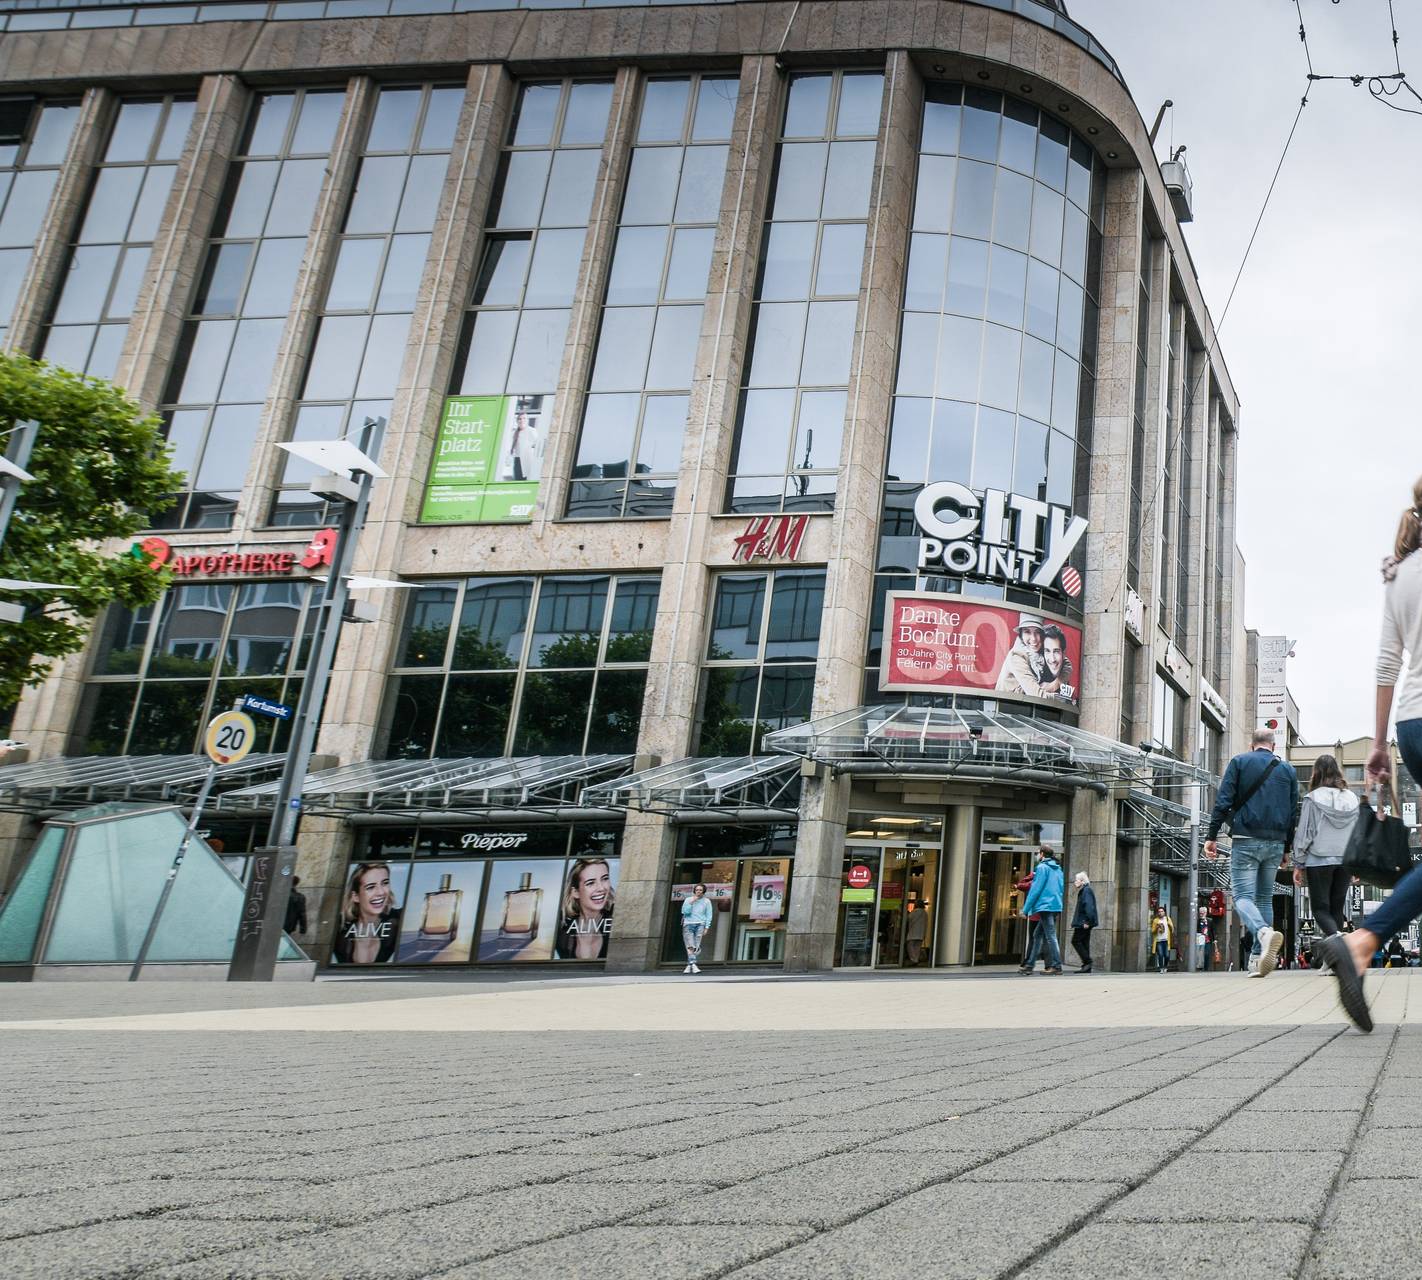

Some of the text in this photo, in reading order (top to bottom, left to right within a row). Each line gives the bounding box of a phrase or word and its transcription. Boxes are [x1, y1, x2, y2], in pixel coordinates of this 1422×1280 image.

[448, 402, 473, 416] Ihr
[444, 419, 492, 434] Start-
[440, 437, 482, 456] platz
[732, 515, 810, 562] H&M
[914, 481, 1089, 587] CITY
[171, 552, 296, 576] APOTHEKE
[918, 538, 1036, 584] POINT
[900, 606, 960, 627] Danke
[899, 626, 980, 648] Bochum.
[897, 648, 909, 657] 30
[911, 649, 935, 659] Jahre
[936, 651, 953, 661] City
[897, 657, 932, 670] Feiern
[936, 659, 954, 671] Sie
[216, 725, 246, 751] 20
[461, 833, 528, 851] Pieper
[754, 884, 782, 901] 16%
[345, 922, 392, 939] ALIVE
[566, 918, 614, 935] ALIVE
